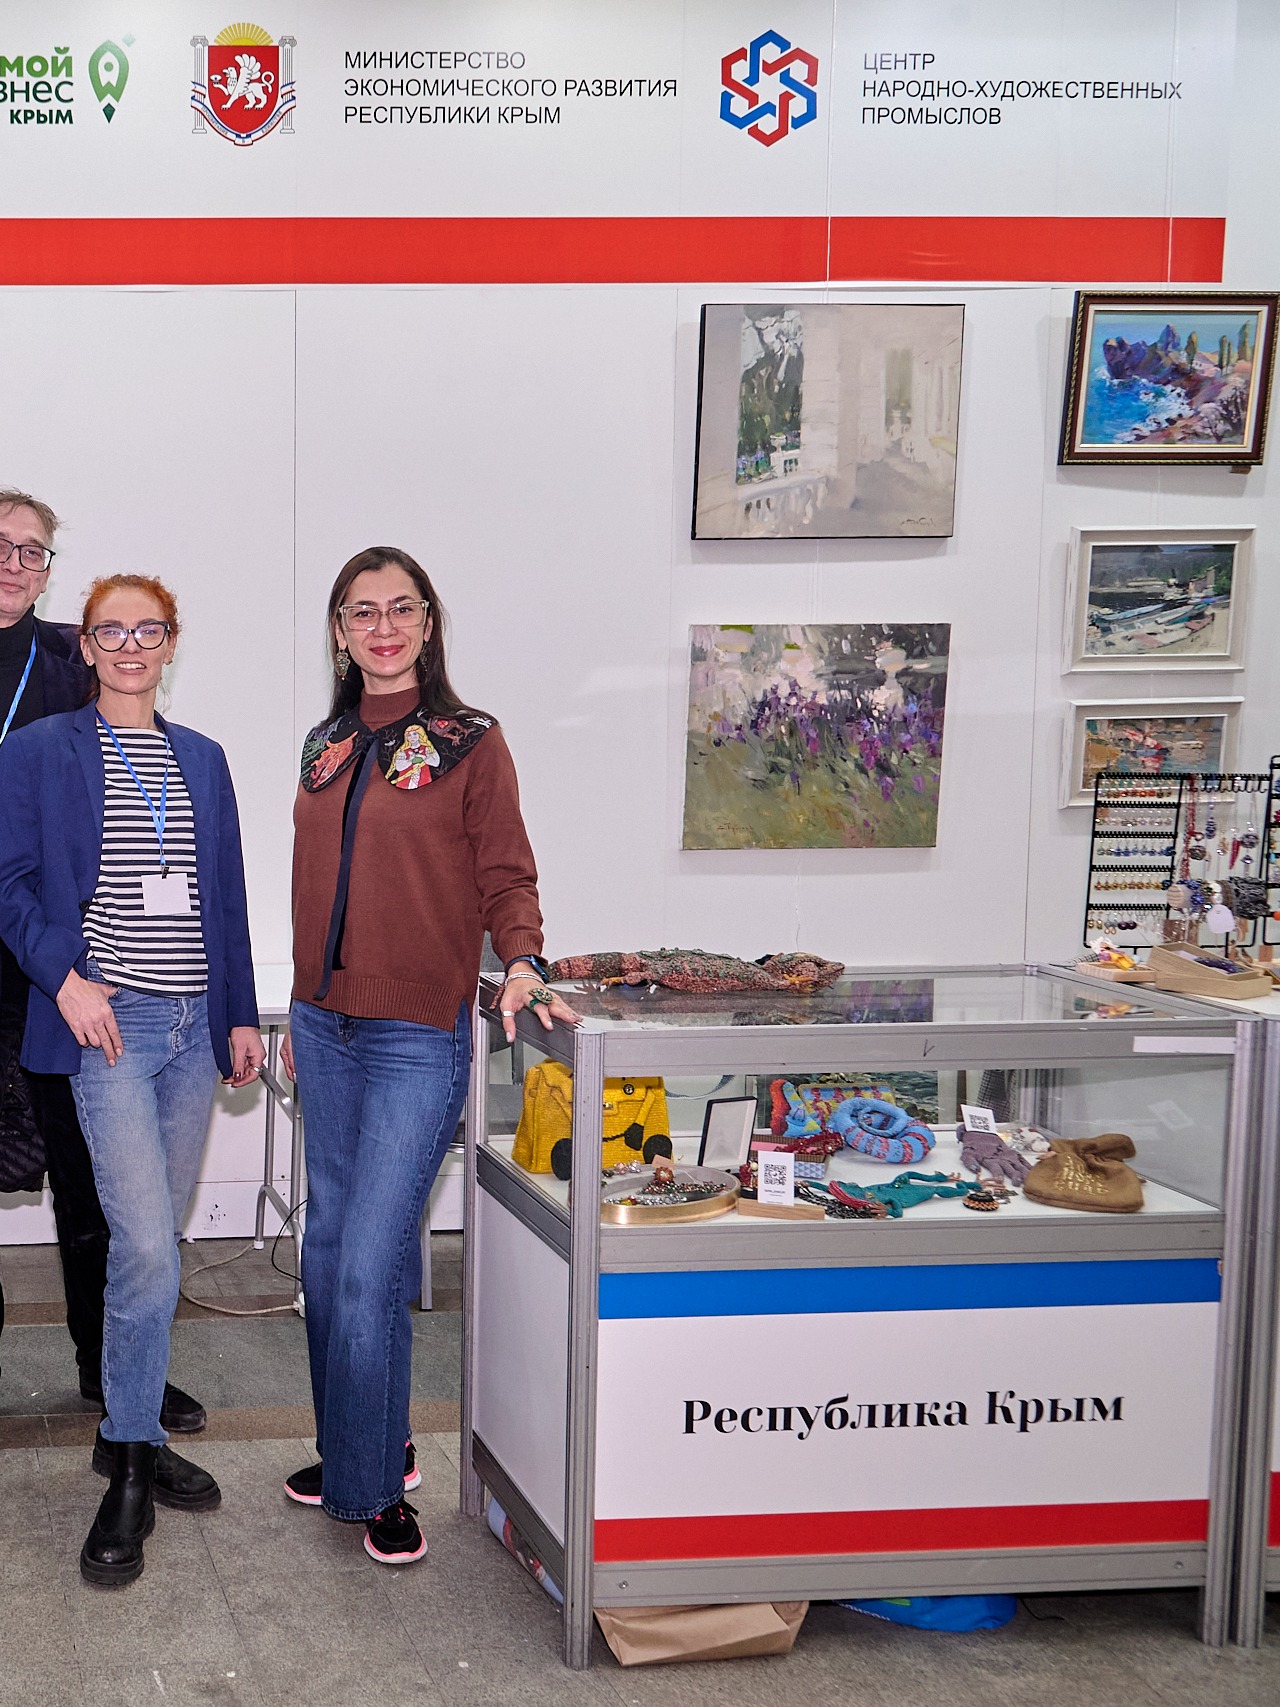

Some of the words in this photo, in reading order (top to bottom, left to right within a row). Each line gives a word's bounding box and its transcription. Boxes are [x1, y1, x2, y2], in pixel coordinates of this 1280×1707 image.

[344, 51, 526, 69] МИНИСТЕРСТВО
[863, 53, 935, 74] ЦЕНТР
[344, 79, 557, 97] ЭКОНОМИЧЕСКОГО
[564, 79, 678, 97] РАЗВИТИЯ
[862, 80, 1183, 101] НАРОДНО-ХУДОЖЕСТВЕННЫХ
[10, 109, 74, 124] КРЫМ
[344, 106, 490, 124] РЕСПУБЛИКИ
[498, 106, 561, 124] КРЫМ
[862, 107, 1001, 125] ПРОМЫСЛОВ
[682, 1393, 969, 1440] Республика
[985, 1390, 1126, 1433] Крым
